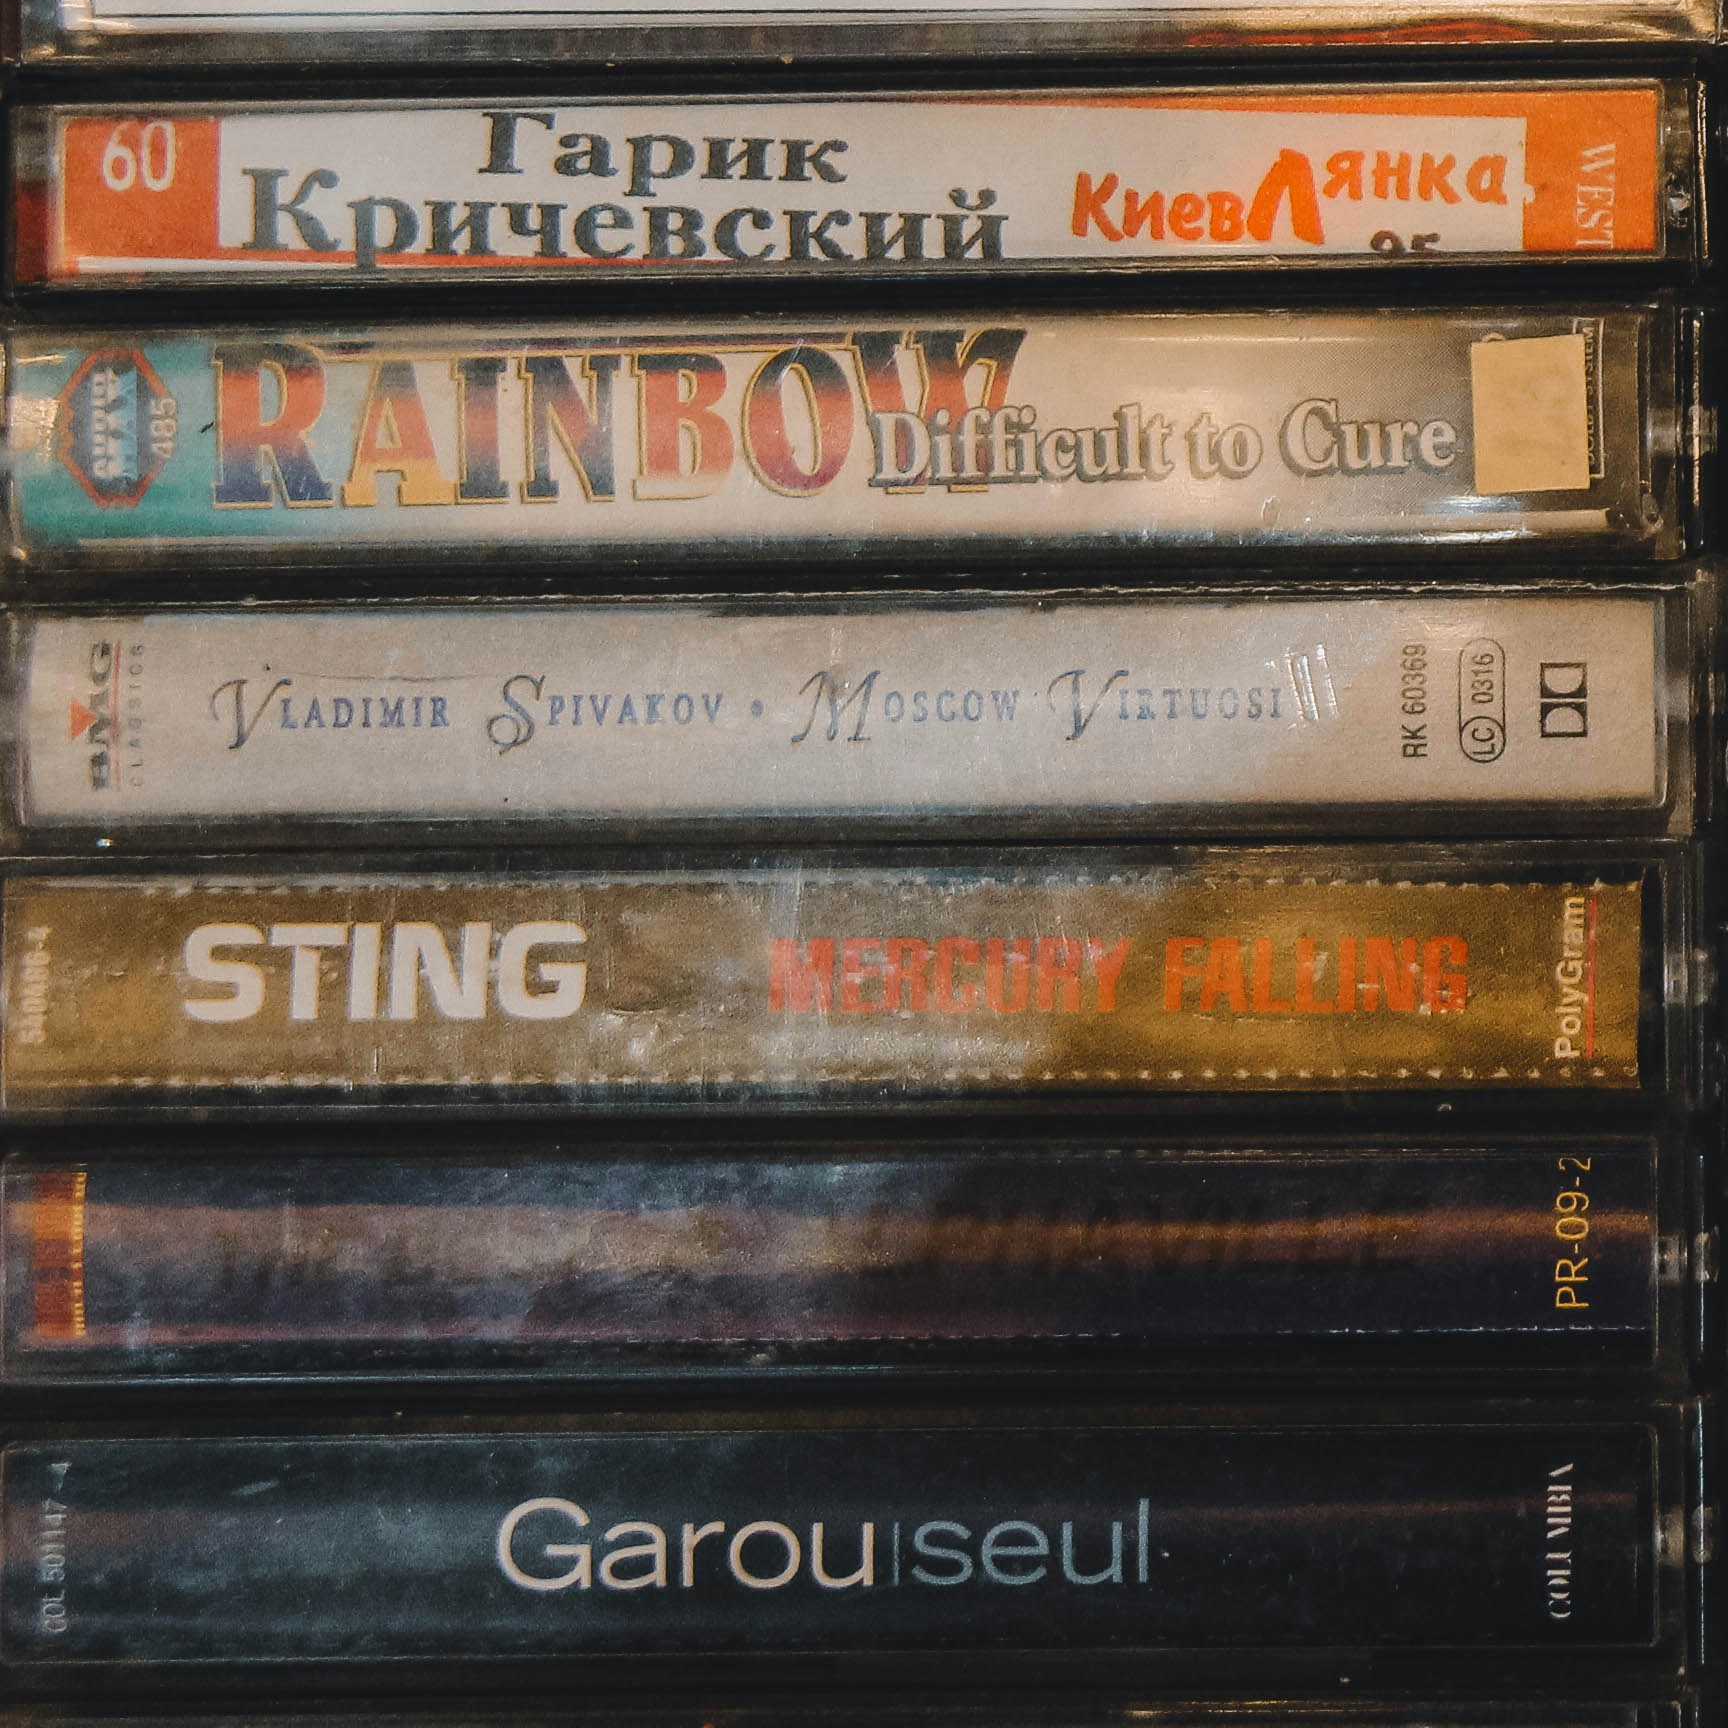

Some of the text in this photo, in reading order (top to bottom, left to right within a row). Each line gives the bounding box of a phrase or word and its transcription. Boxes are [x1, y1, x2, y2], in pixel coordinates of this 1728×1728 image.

[100, 122, 176, 193] 60
[478, 110, 850, 199] Гарик
[1071, 148, 1510, 246] КиевЛянка
[241, 168, 1008, 269] Кричевский
[151, 397, 179, 460] 485
[212, 328, 1026, 510] RAINBOW
[870, 397, 1456, 486] Difficult to Cure
[211, 669, 1283, 757] VLADIMIR SPIVAKOV MOSCOW VIRTUOSI
[1403, 643, 1428, 759] RK 60369
[183, 922, 1469, 1021] STING MERCURY FALLING
[1555, 894, 1586, 1060] PolyGram
[1555, 1156, 1592, 1310] PR-09-2
[496, 1496, 1151, 1592] Garou seul
[1547, 1463, 1573, 1621] COLUMBIA
